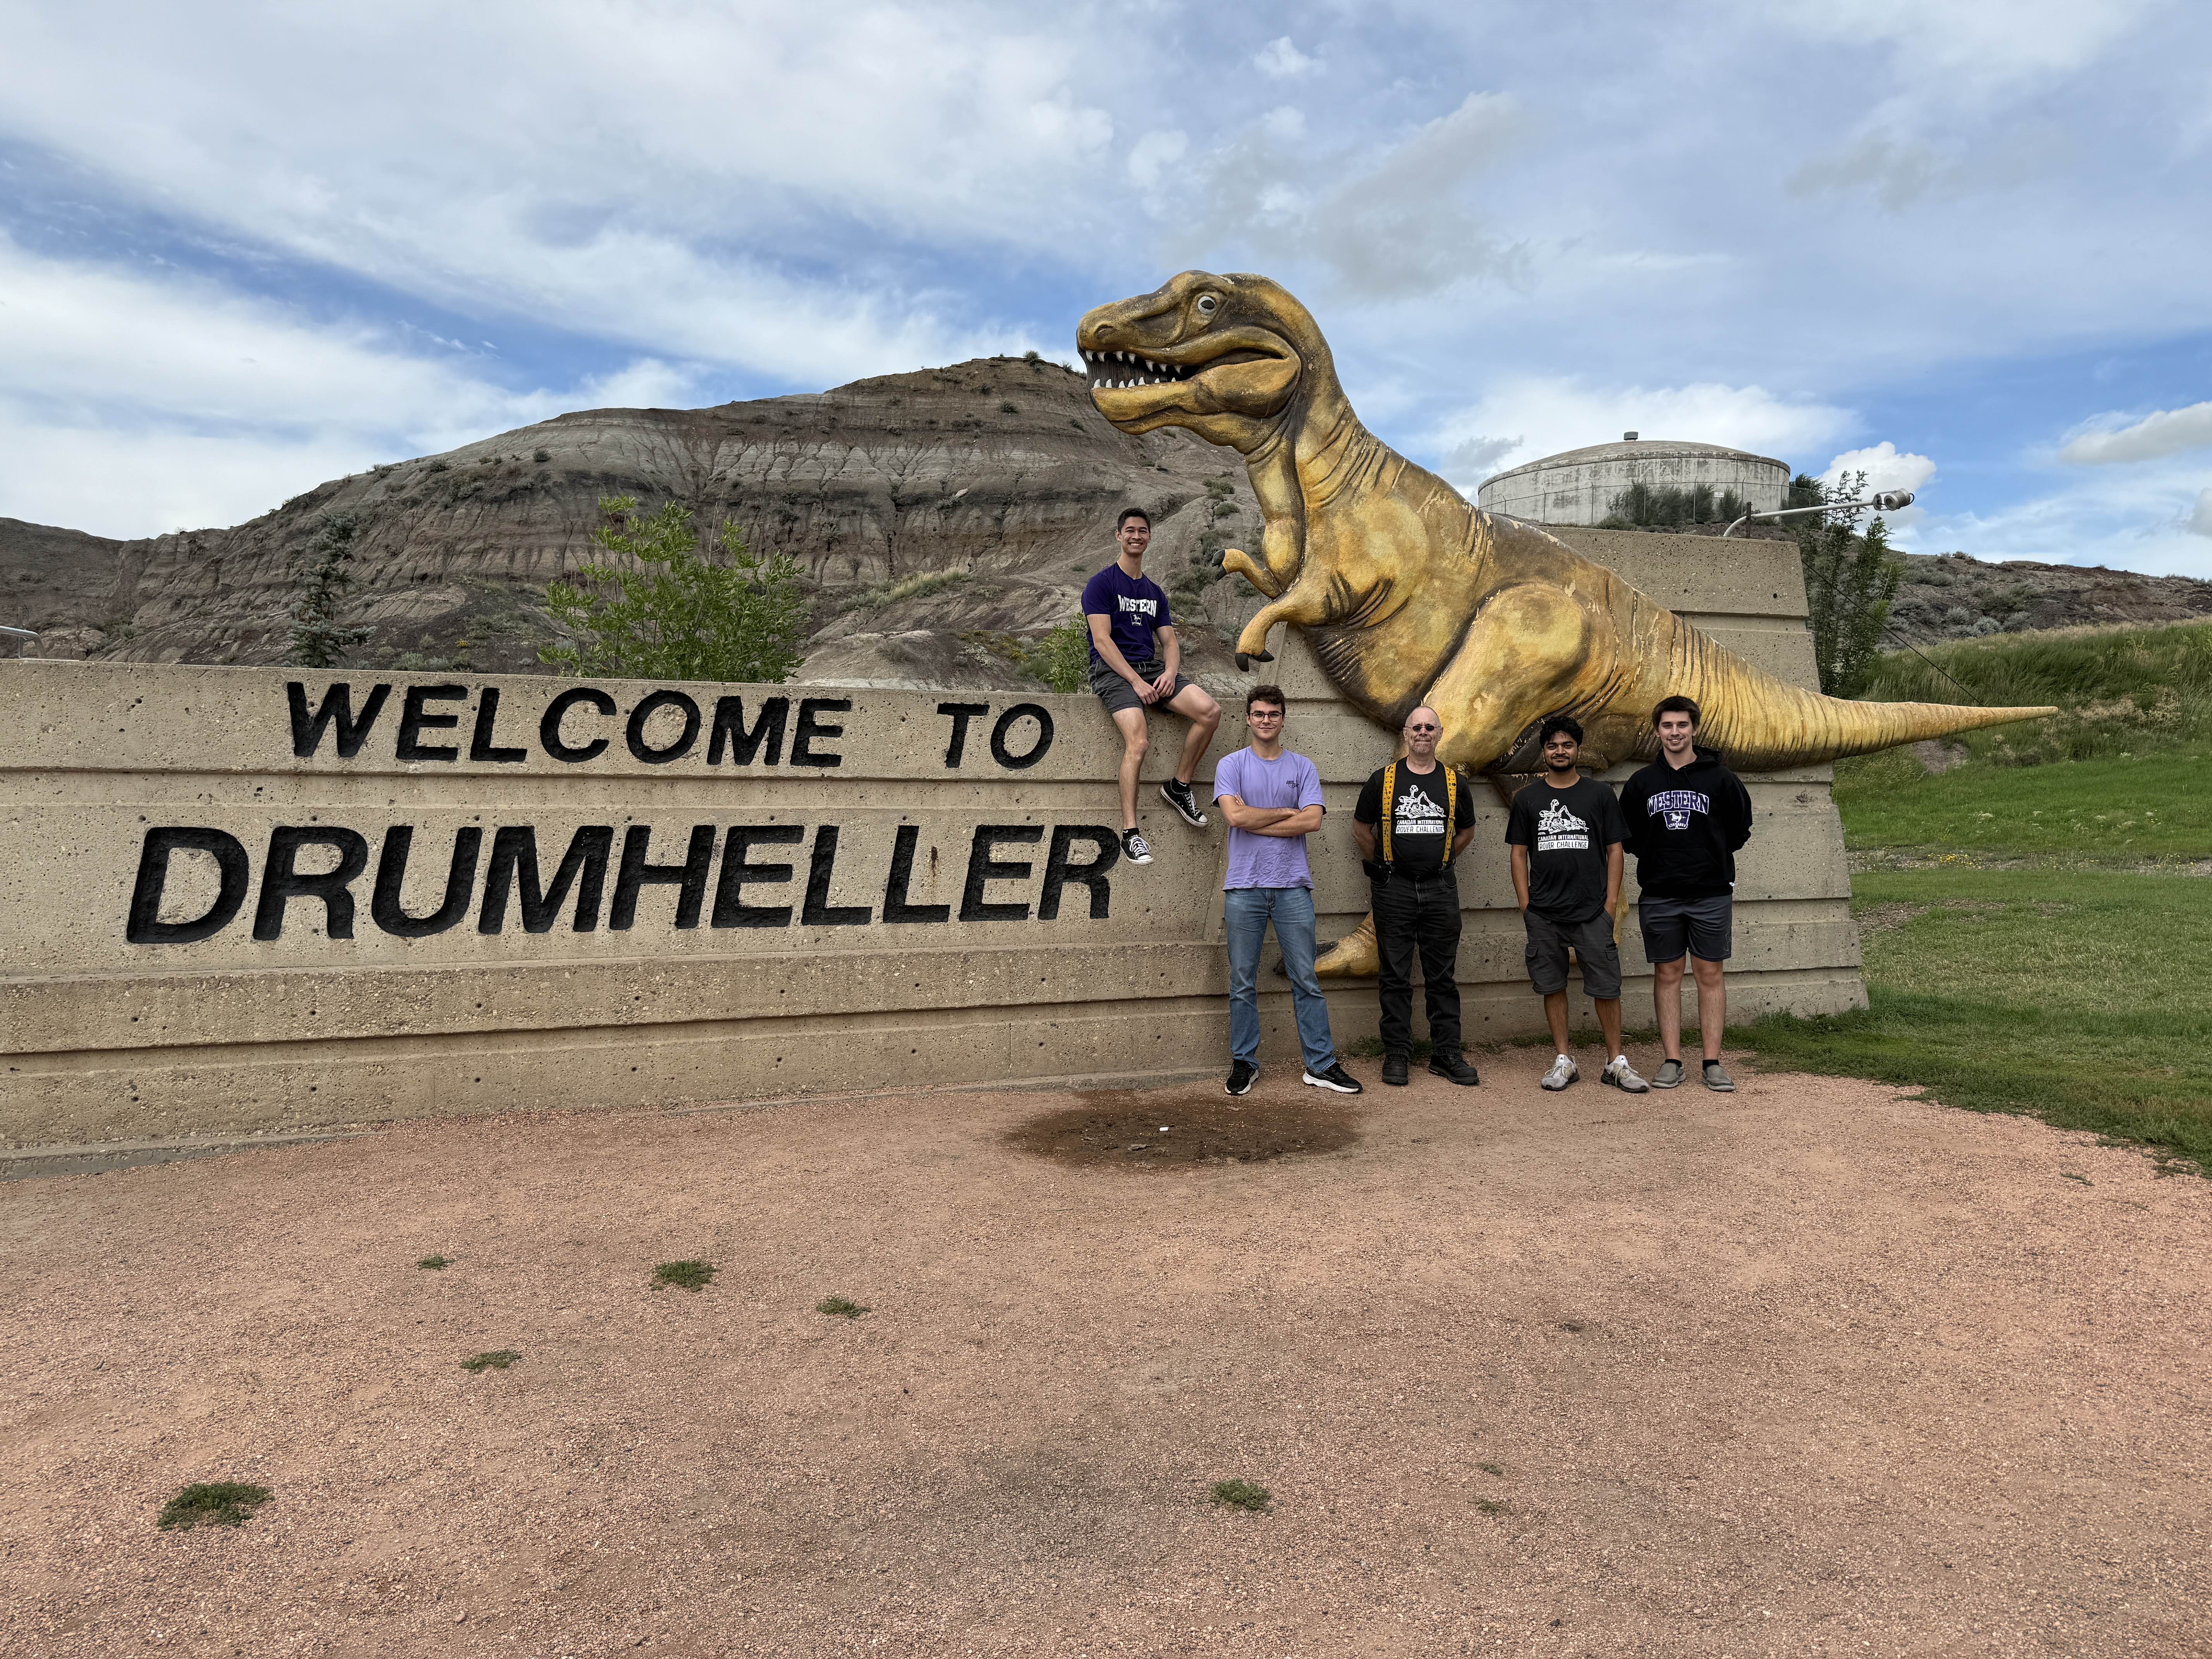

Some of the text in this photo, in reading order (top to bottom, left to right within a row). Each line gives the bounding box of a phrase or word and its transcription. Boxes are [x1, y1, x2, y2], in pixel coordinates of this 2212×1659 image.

[1118, 594, 1157, 617] WESTERN
[287, 682, 1054, 770] WELCOME TO
[1647, 790, 1709, 817] WESTERN
[1540, 842, 1554, 850] ROVER
[126, 824, 1121, 944] DRUMHELLER
